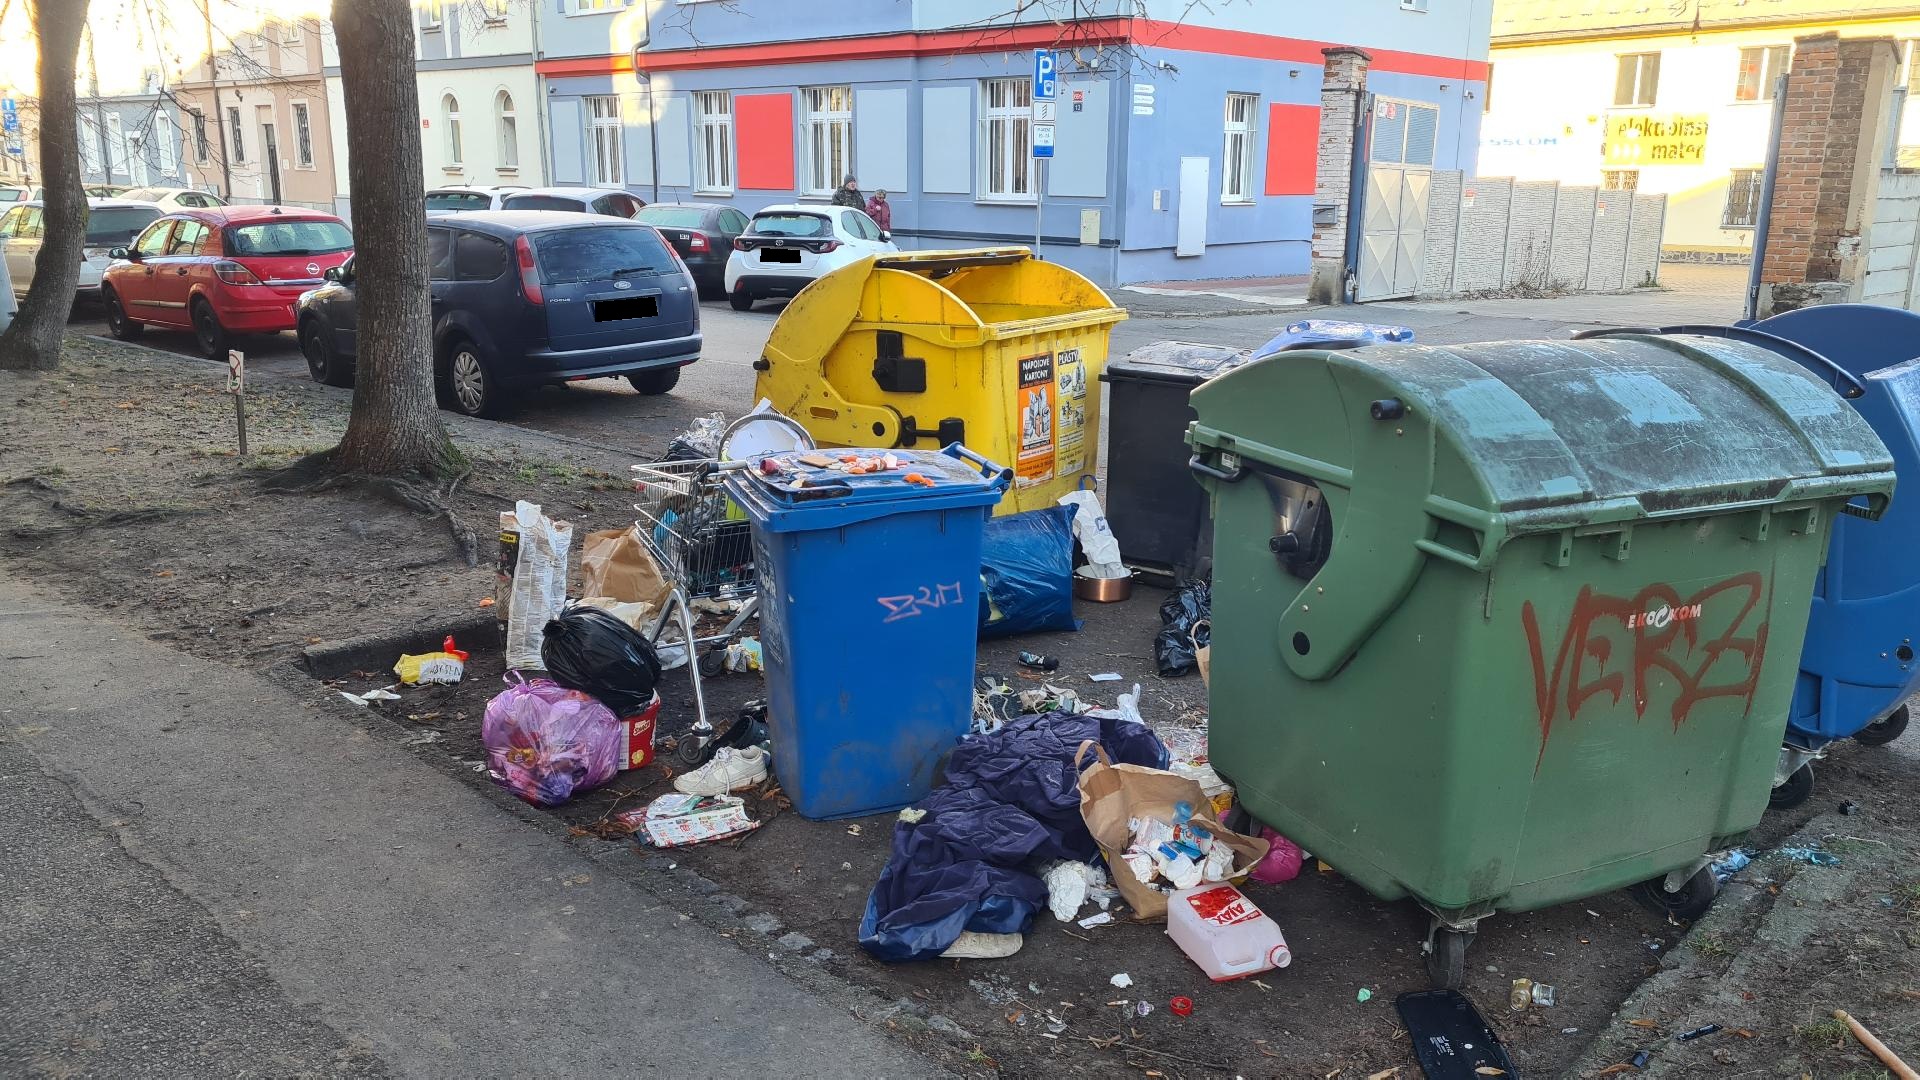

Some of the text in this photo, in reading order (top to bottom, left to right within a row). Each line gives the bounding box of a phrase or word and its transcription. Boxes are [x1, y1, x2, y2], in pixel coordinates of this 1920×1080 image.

[1039, 56, 1053, 84] P
[1059, 350, 1078, 365] PLASTY
[1024, 369, 1049, 382] KARTONY
[1214, 903, 1246, 925] AJAX
